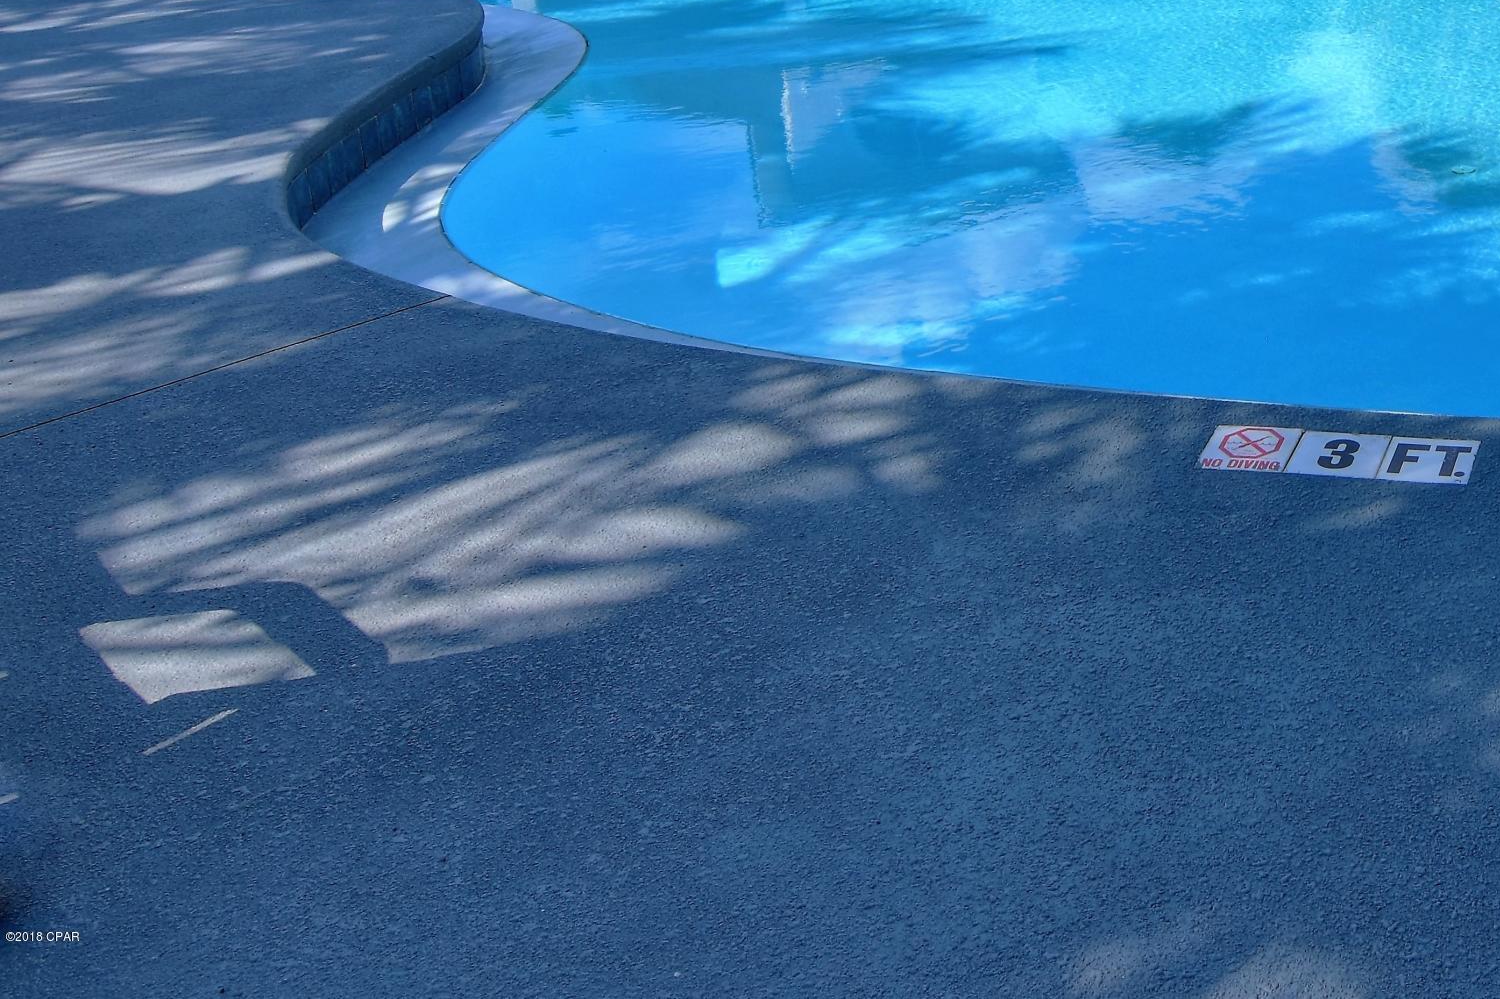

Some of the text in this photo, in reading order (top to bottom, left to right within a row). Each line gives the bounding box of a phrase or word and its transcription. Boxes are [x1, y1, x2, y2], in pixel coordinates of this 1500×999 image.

[1201, 457, 1281, 471] NO DIVING
[1316, 438, 1361, 469] 3
